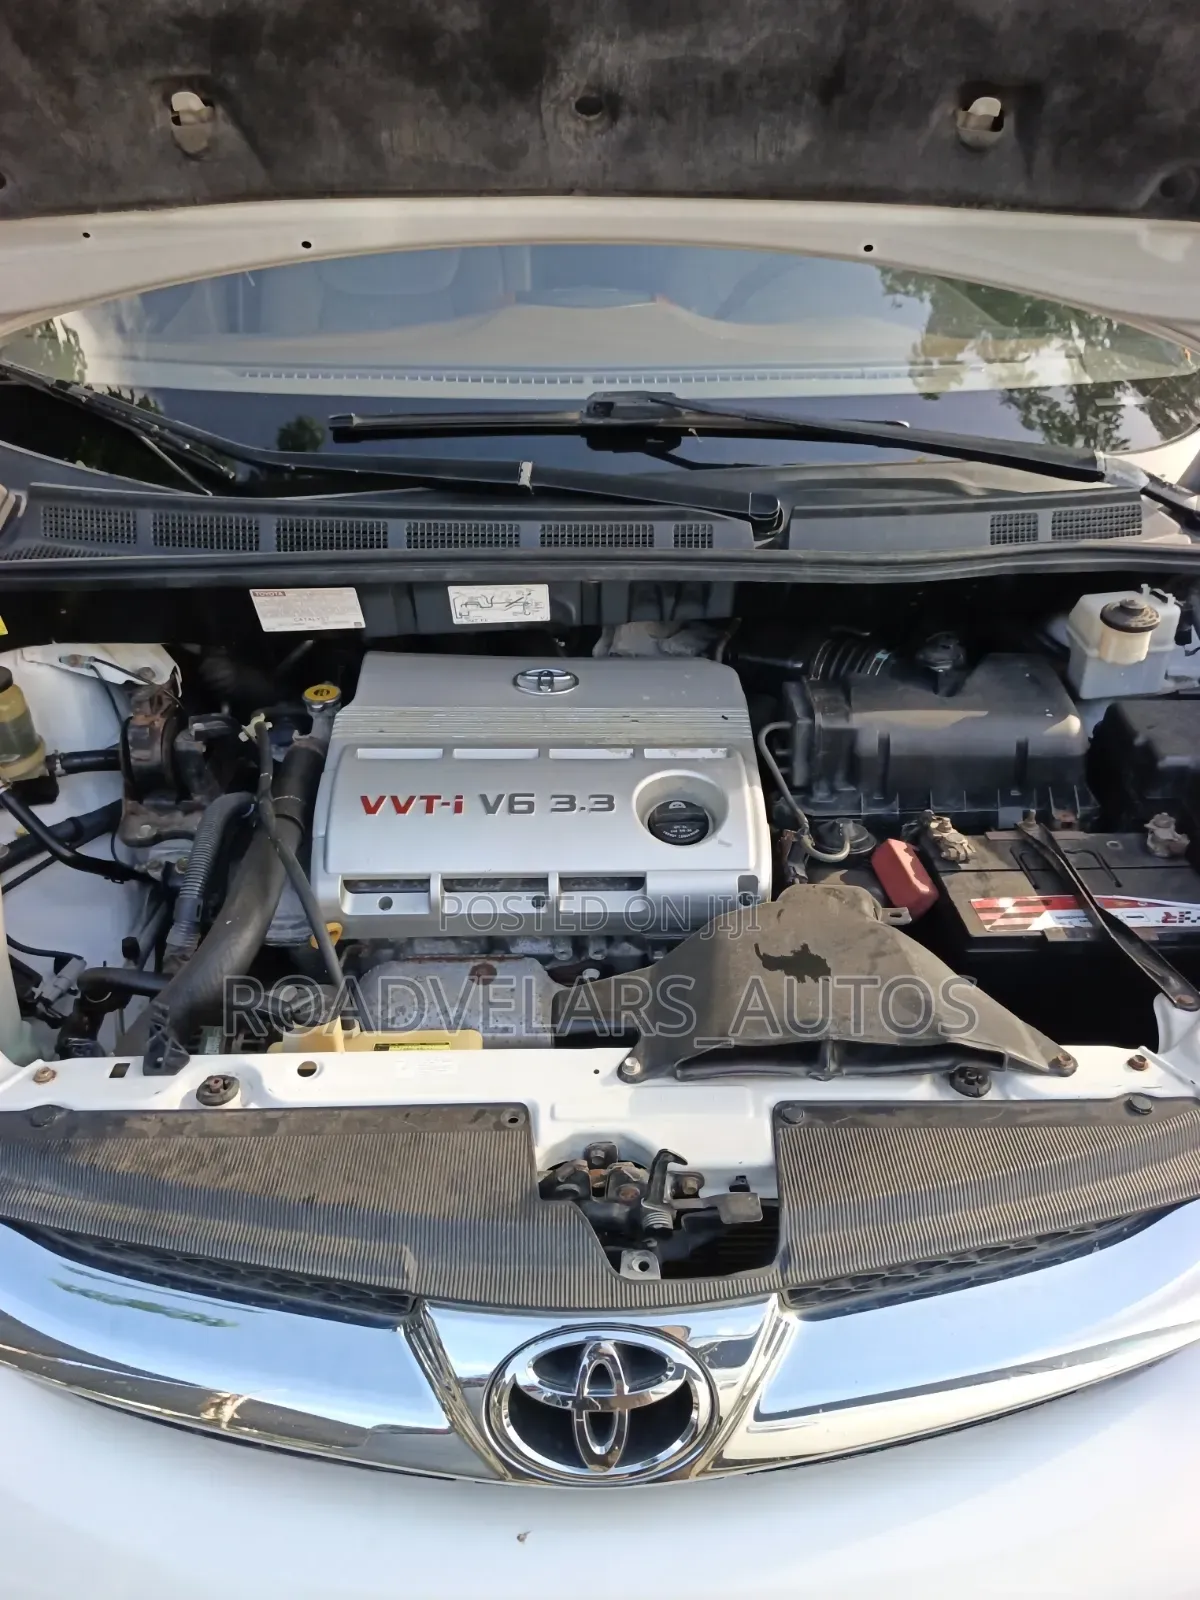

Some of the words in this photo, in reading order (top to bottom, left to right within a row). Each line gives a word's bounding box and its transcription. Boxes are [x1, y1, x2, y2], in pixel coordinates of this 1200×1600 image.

[359, 794, 465, 816] VVT-i
[479, 793, 537, 816] V6
[549, 794, 616, 813] 3.3
